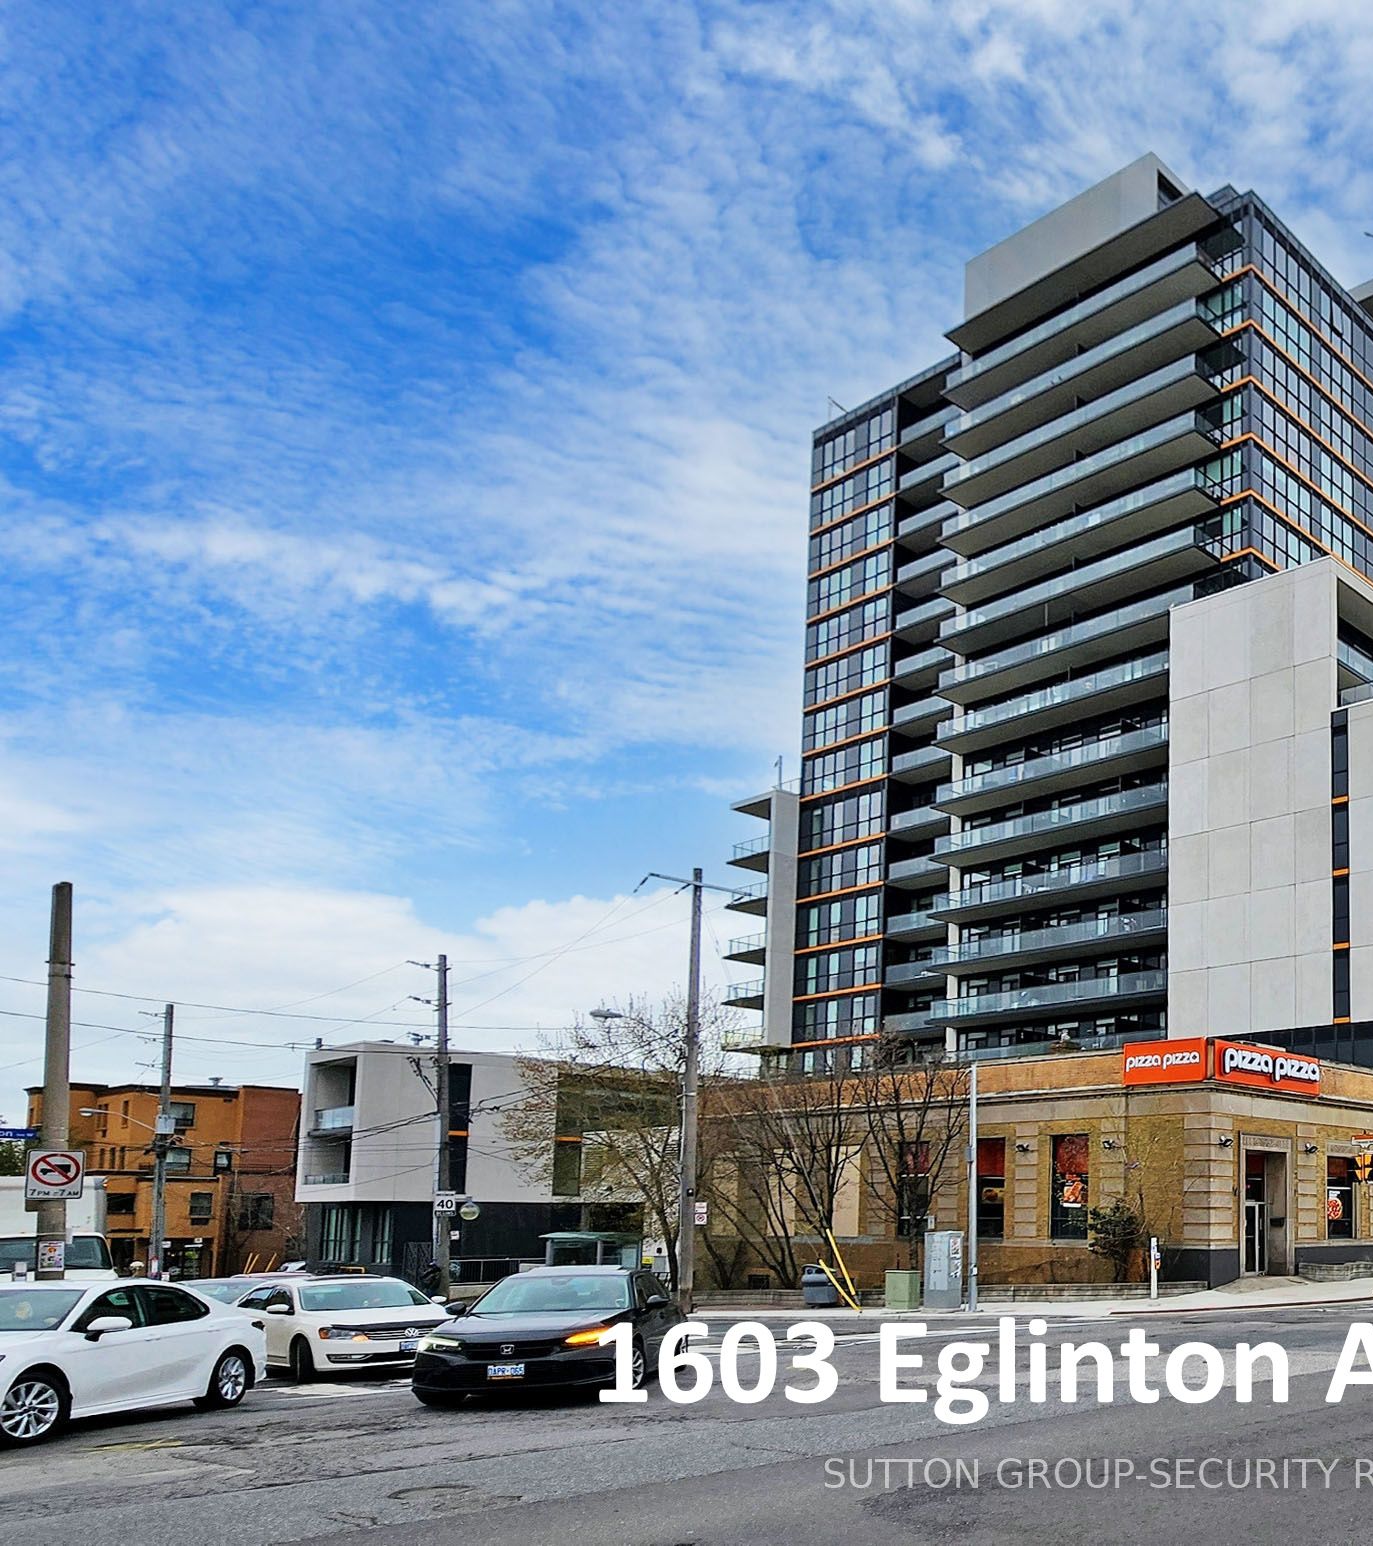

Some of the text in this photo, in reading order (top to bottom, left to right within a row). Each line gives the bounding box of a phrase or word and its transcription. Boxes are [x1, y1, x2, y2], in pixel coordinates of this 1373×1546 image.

[1125, 1051, 1200, 1073] pizza pizza
[1224, 1047, 1320, 1082] pizza pizza
[29, 1188, 37, 1196] 7
[436, 1199, 454, 1209] 40
